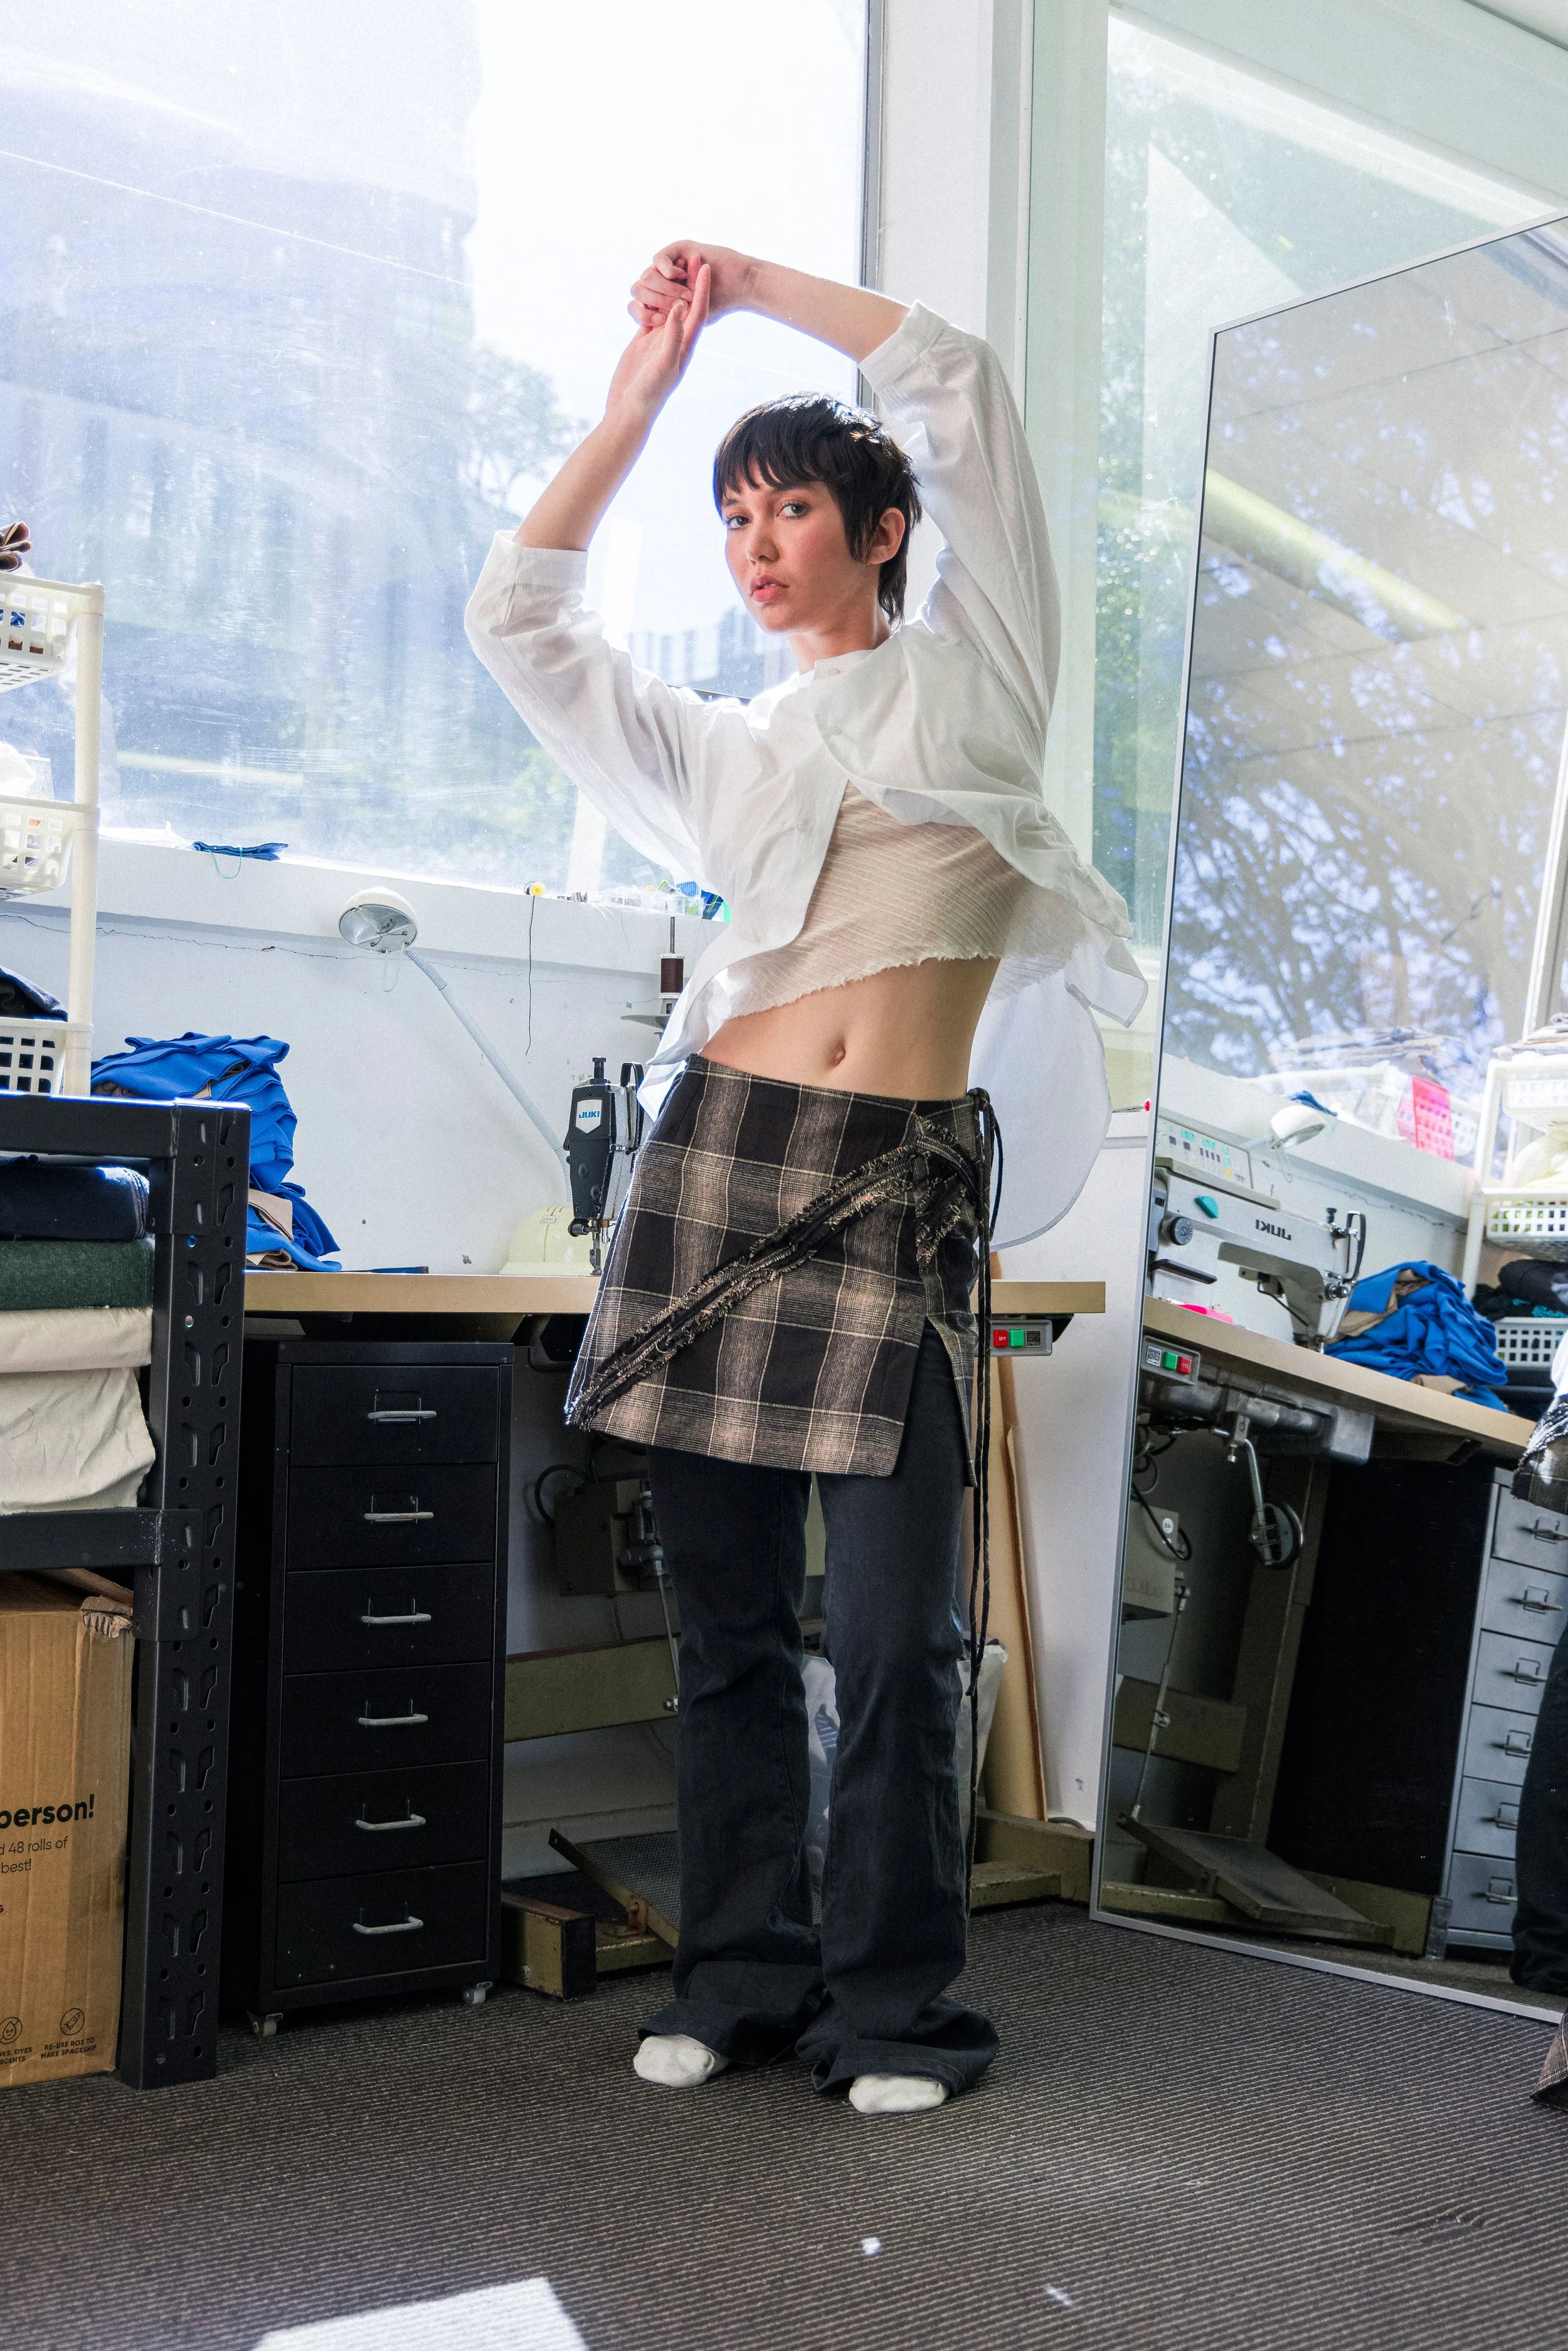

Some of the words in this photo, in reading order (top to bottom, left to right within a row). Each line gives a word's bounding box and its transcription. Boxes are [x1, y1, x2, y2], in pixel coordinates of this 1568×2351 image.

[8, 1841, 24, 1854] 48
[28, 1838, 51, 1852] rolls
[55, 1835, 68, 1849] of
[1, 1859, 32, 1874] best!
[41, 2051, 60, 2059] MAKE
[61, 2044, 97, 2056] SPACESHIP
[45, 2041, 69, 2051] RE-USE
